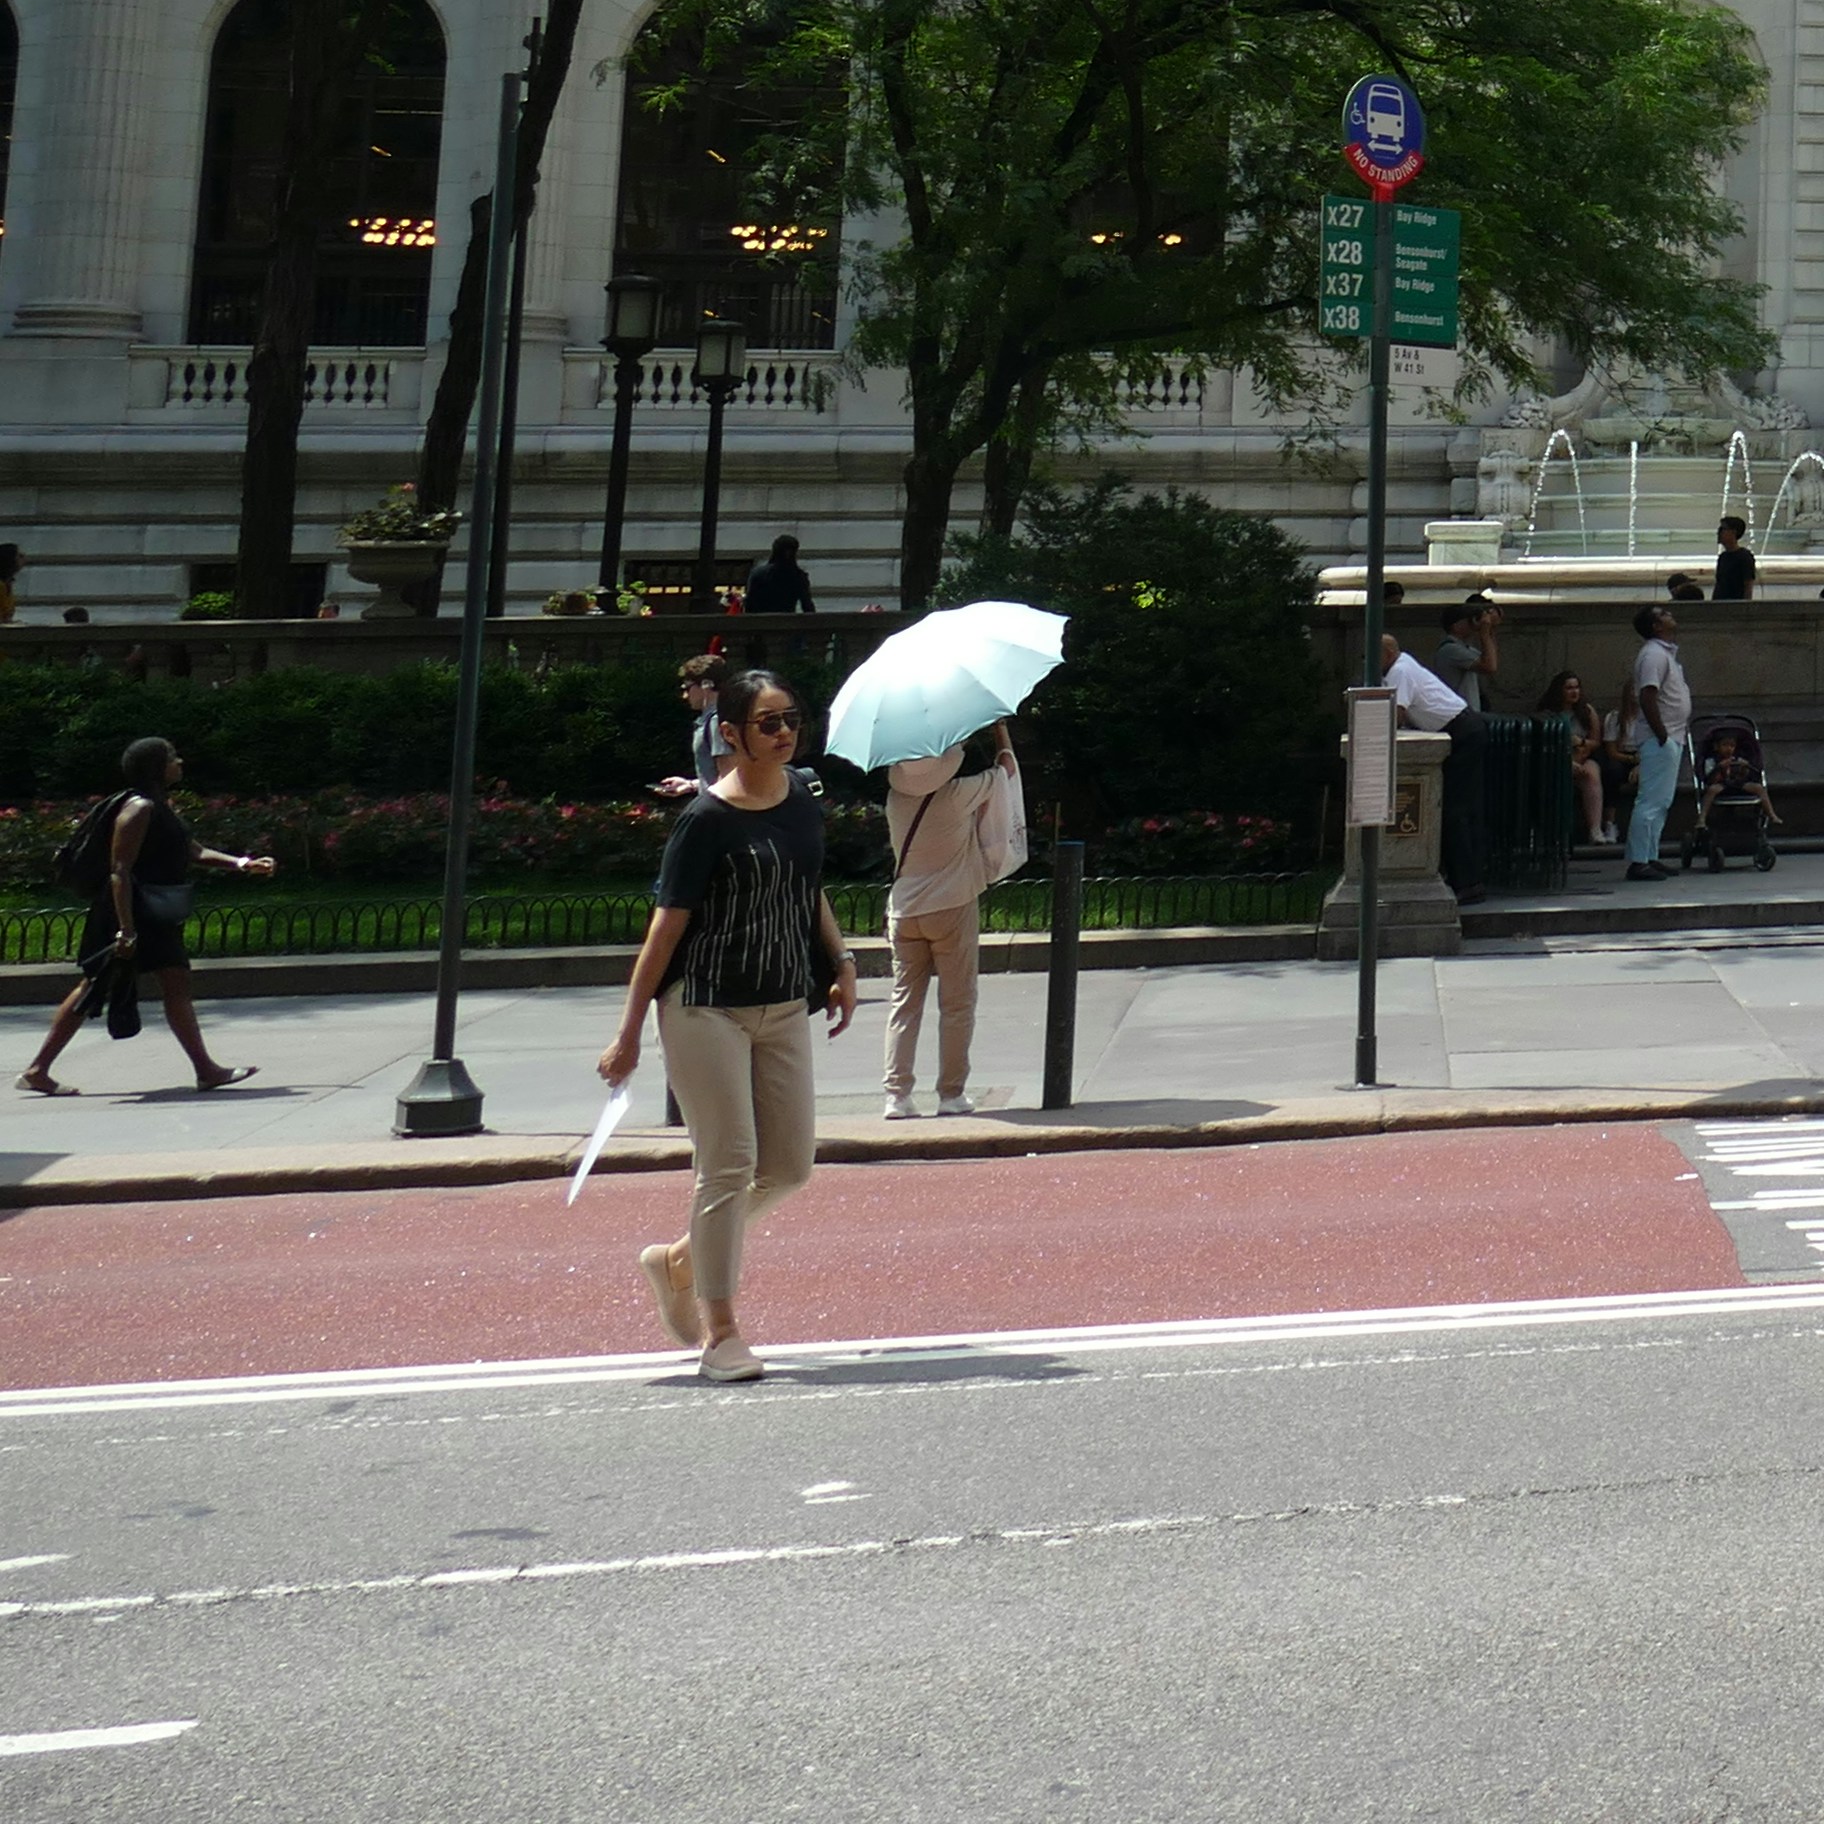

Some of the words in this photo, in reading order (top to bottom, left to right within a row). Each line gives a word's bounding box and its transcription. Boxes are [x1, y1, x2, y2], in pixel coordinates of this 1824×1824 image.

[1352, 148, 1370, 168] NO
[1367, 155, 1419, 182] STANDING
[1395, 310, 1444, 326] Bensonhurst
[1394, 347, 1400, 360] 5
[1394, 361, 1403, 373] W
[1404, 363, 1414, 375] 41
